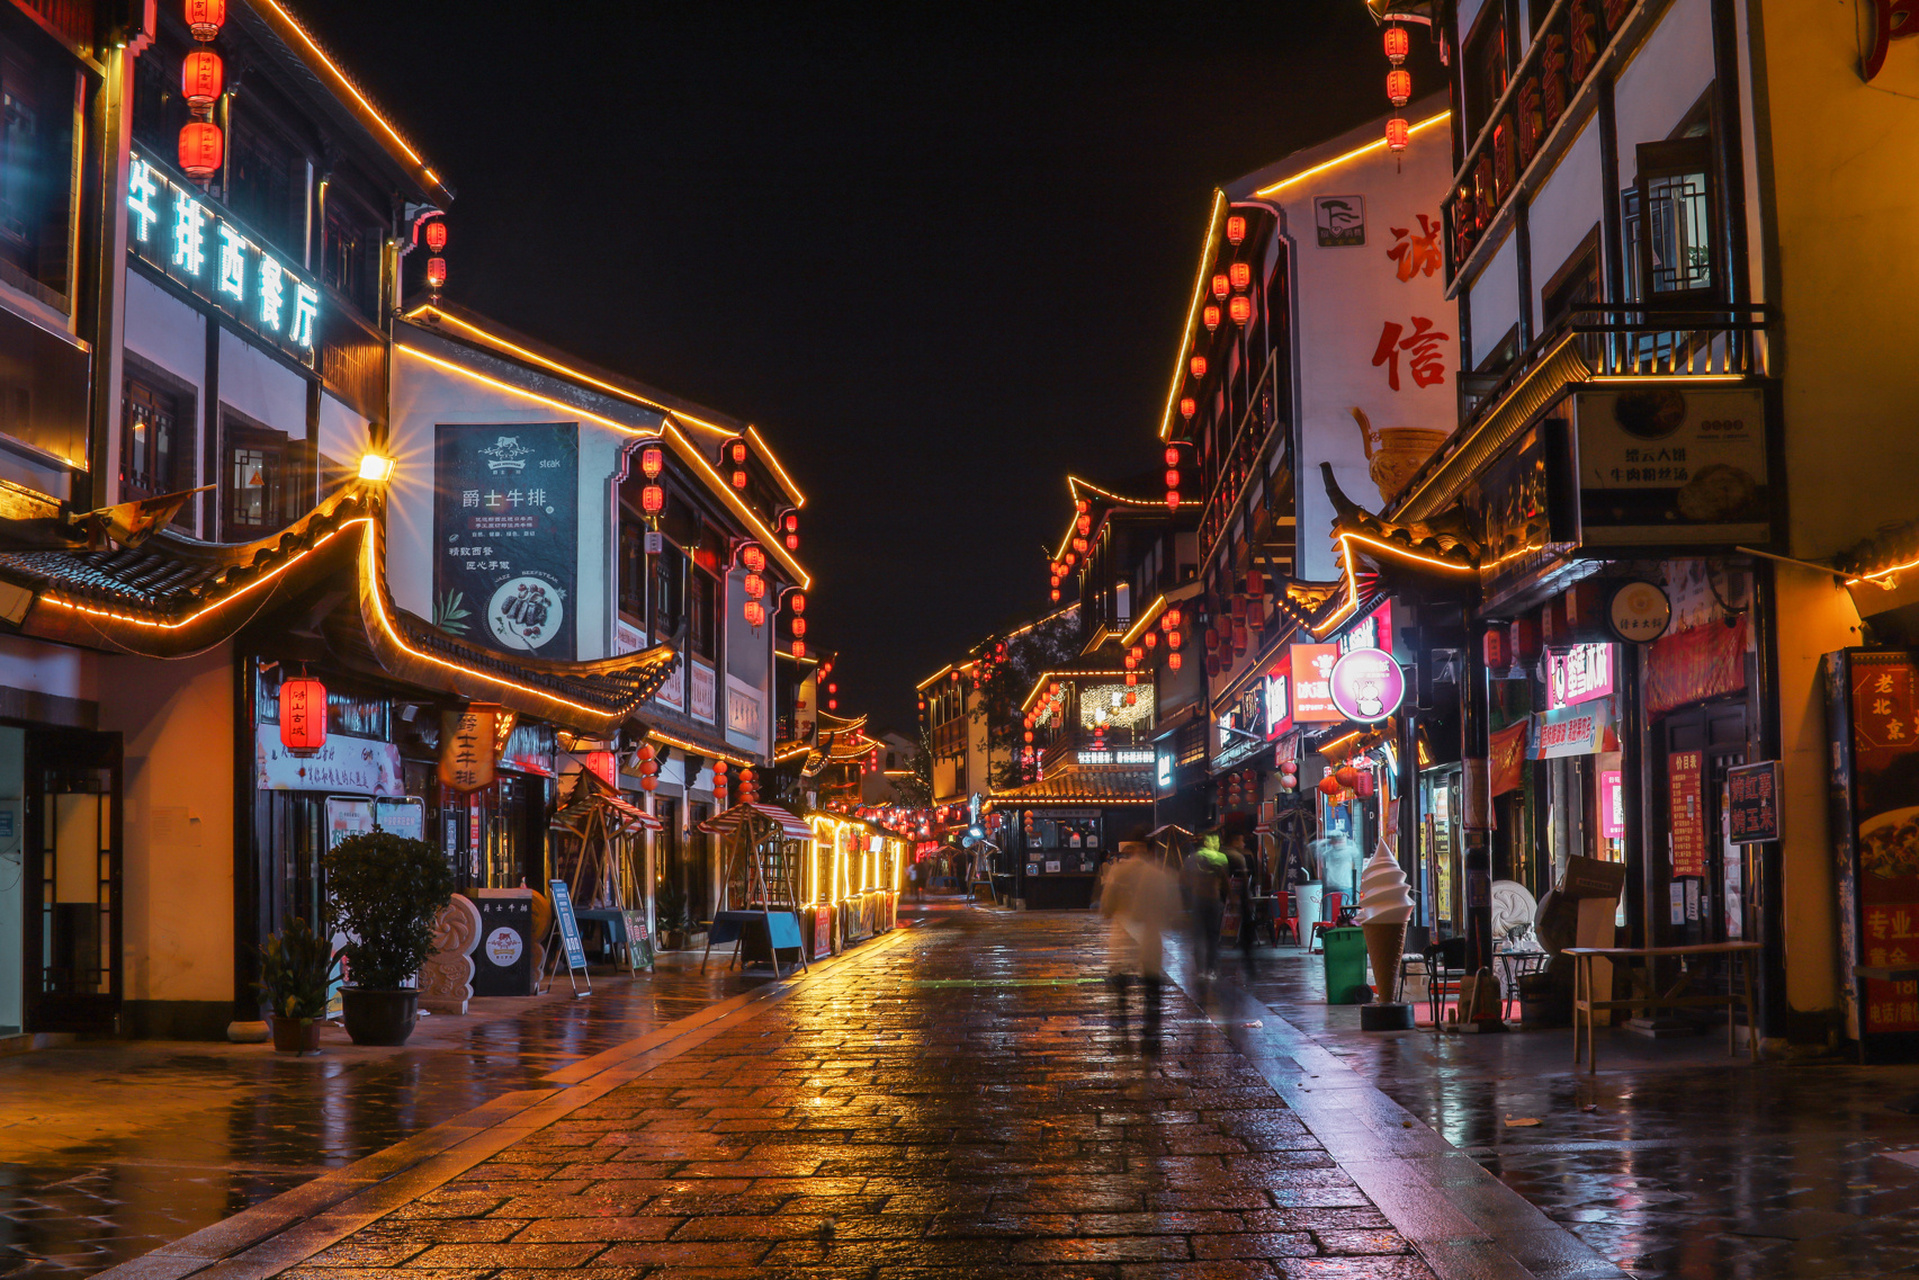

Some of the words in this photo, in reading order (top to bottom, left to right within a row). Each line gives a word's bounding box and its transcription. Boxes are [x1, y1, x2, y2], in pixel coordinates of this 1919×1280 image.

[128, 159, 319, 348] 牛排西餐厅
[1372, 214, 1449, 391] 诚信
[1611, 467, 1688, 482] 牛肉粉丝汤
[462, 488, 546, 508] 爵士牛排
[448, 546, 494, 557] 精致西餐
[521, 570, 559, 584] BEEFSTEAK
[1872, 673, 1906, 741] 老北京
[455, 713, 478, 786] 爵士牛排
[1675, 754, 1697, 771] 价目表
[1731, 773, 1773, 803] 烤红薯
[1731, 805, 1775, 834] 烤玉米
[483, 903, 528, 913] 爵士牛排
[1868, 910, 1919, 940] 专业
